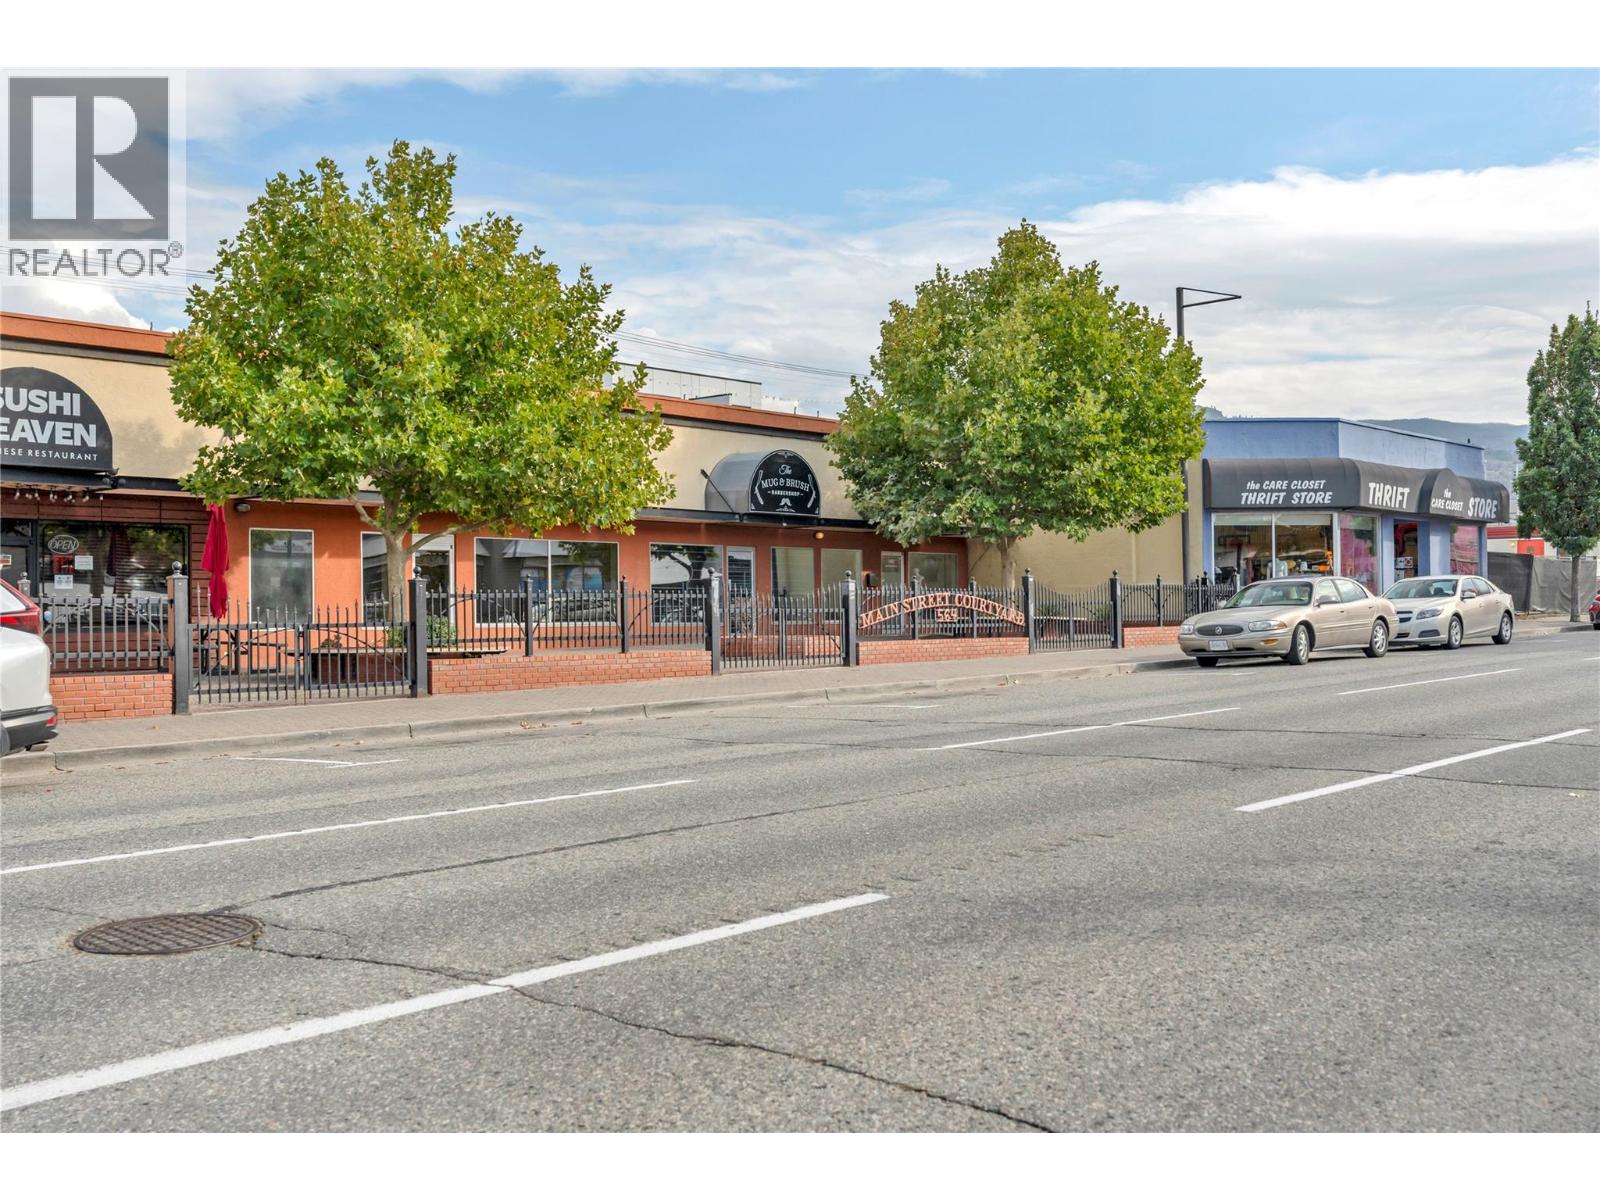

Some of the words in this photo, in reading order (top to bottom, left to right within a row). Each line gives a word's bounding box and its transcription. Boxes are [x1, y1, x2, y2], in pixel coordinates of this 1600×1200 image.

[0, 387, 80, 416] USHI
[0, 447, 23, 456] ESE
[28, 449, 98, 461] RESTAURANT
[761, 478, 778, 489] MUG
[779, 478, 785, 487] &
[786, 479, 810, 491] BRUSH
[1246, 481, 1261, 490] the
[1263, 480, 1288, 490] CARE
[1291, 480, 1326, 490] CLOSET
[1241, 492, 1286, 505] THRIFT
[1291, 491, 1333, 505] STORE
[1369, 482, 1410, 509] THRIFT
[1444, 488, 1452, 499] the
[1431, 497, 1445, 509] CARE
[1445, 500, 1464, 511] CLOSET
[1467, 497, 1498, 519] STORE
[51, 539, 77, 550] OPEN
[860, 602, 900, 627] MAIN
[903, 592, 951, 613] STREET
[955, 593, 1025, 626] COURTYARD
